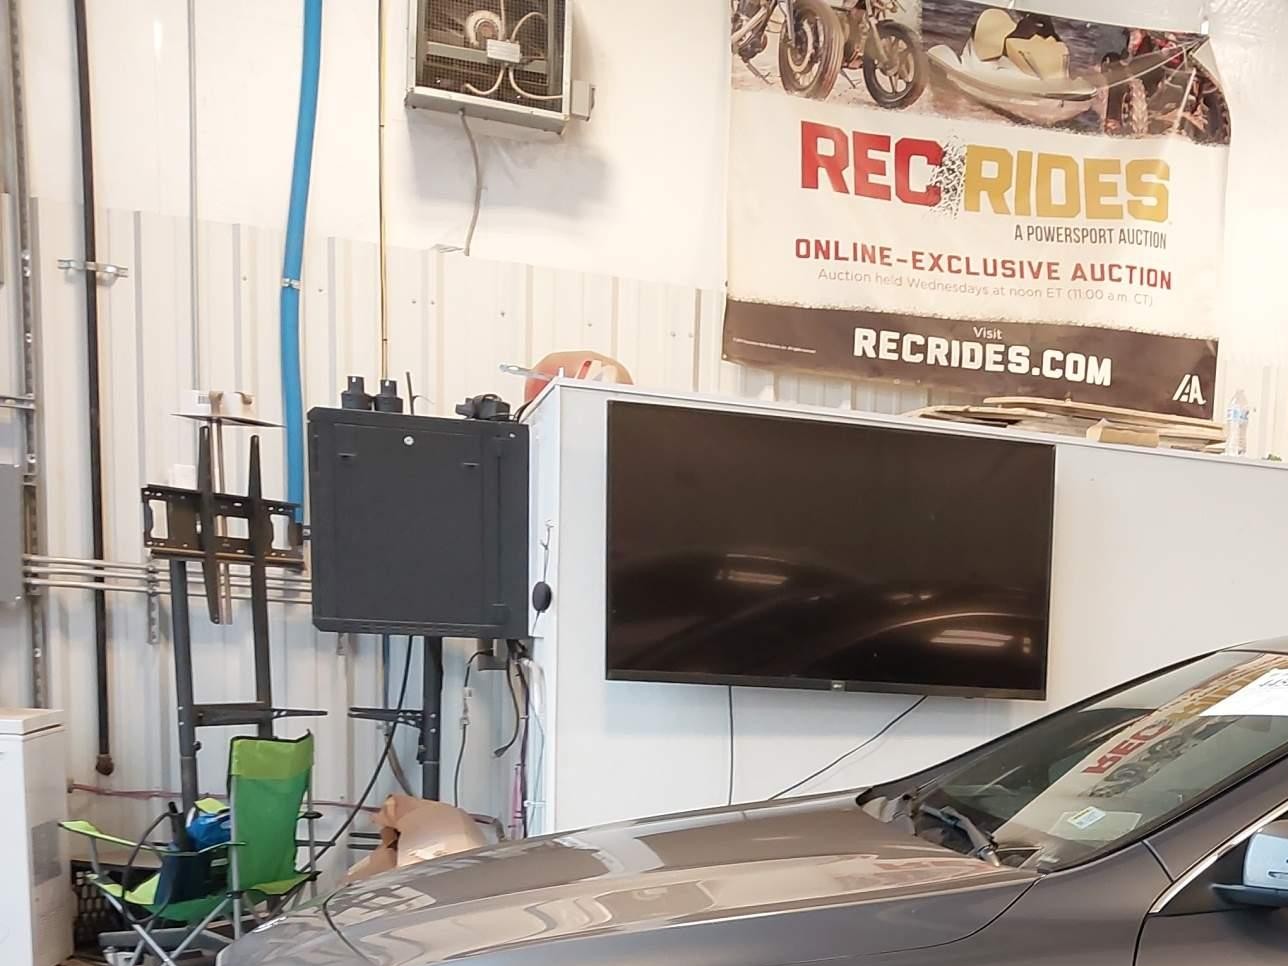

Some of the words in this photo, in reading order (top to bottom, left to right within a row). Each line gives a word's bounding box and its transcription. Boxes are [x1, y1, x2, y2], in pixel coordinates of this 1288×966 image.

[800, 120, 943, 207] REC
[963, 144, 1171, 224] RIDES
[1014, 224, 1023, 241] A
[1027, 225, 1115, 244] POWERSPORT
[1118, 228, 1167, 250] AUCTION
[795, 238, 1061, 281] ONLINE-EXCLUSIVE
[1071, 263, 1172, 290] AUCTION
[818, 268, 871, 283] Auction
[875, 272, 902, 287] held
[907, 277, 989, 296] Wednesdays
[993, 286, 1006, 297] at
[1010, 287, 1042, 298] noon
[1046, 287, 1063, 298] ET
[973, 326, 1003, 340] Visit
[852, 327, 1113, 387] RECRIDES.COM
